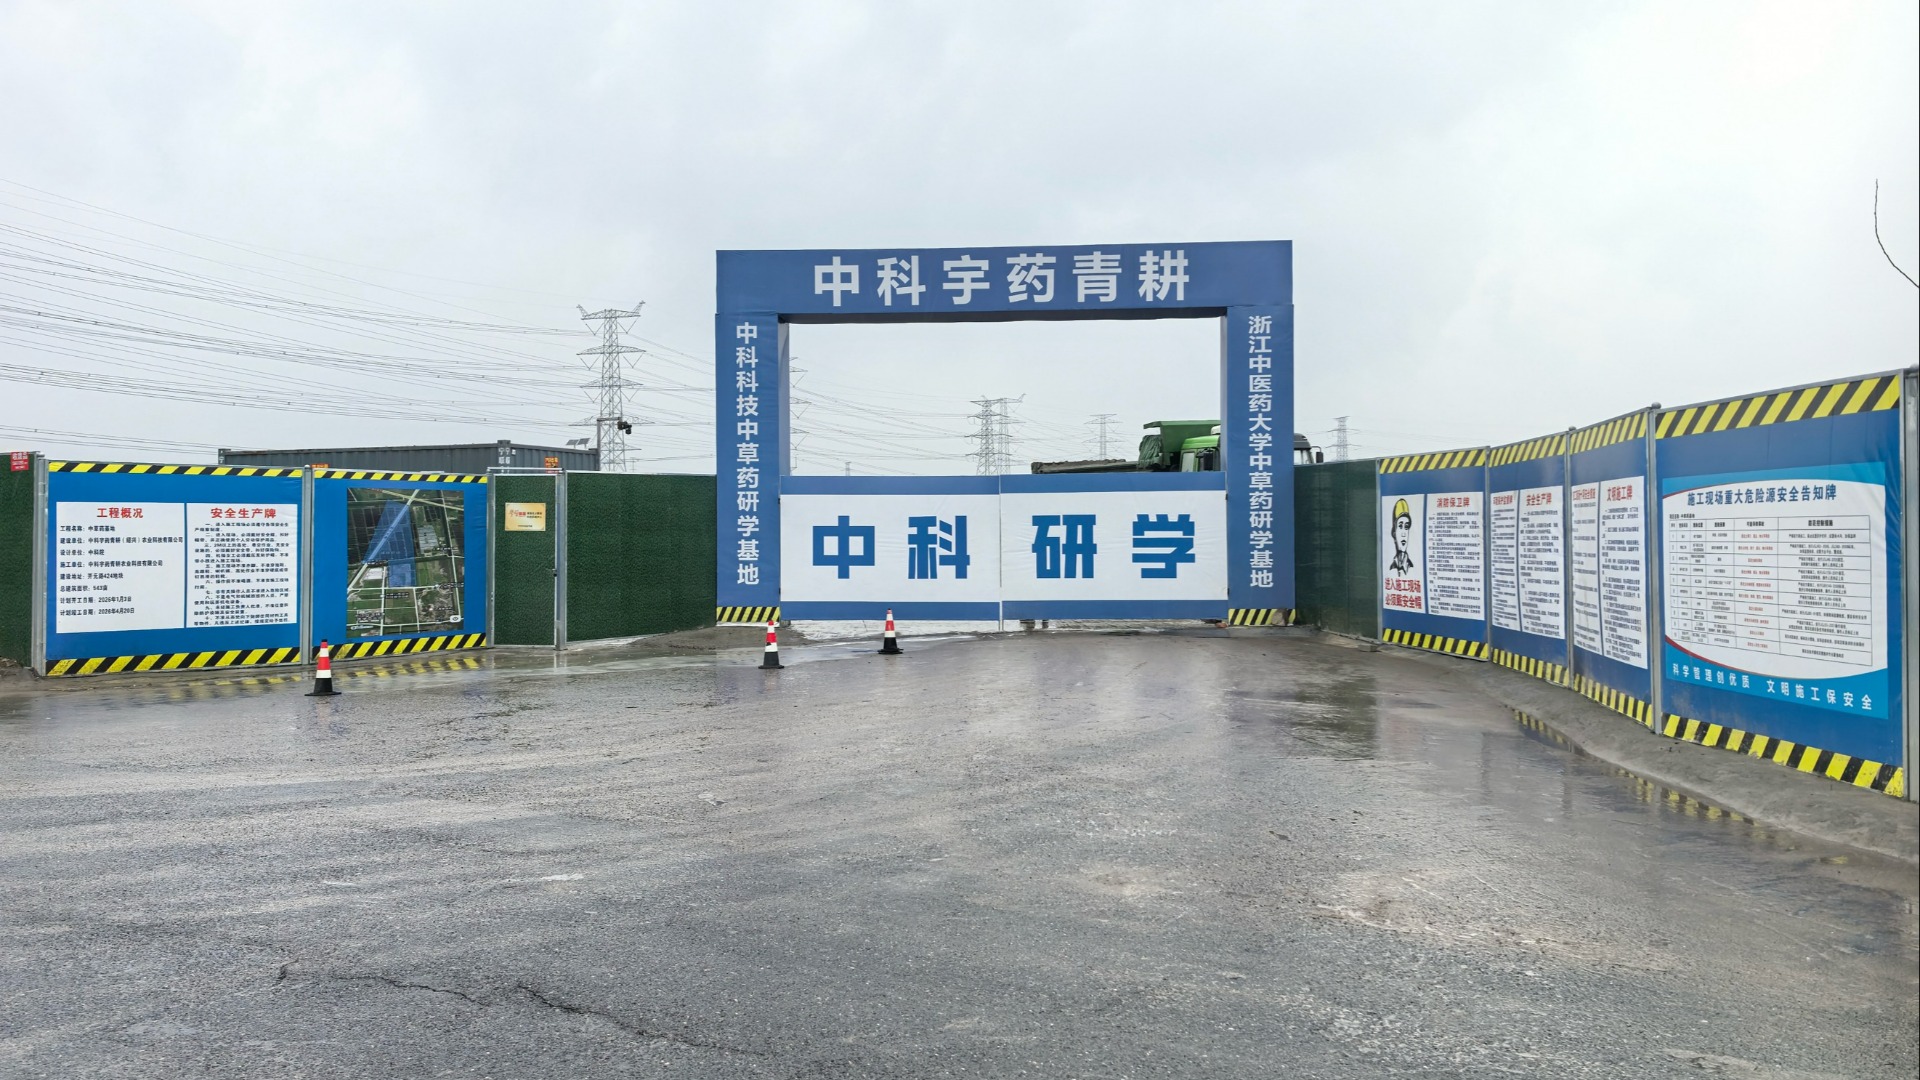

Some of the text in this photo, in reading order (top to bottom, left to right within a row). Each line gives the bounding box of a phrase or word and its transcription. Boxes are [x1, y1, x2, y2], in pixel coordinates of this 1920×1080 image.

[814, 249, 1190, 307] 中科宇药青耕
[735, 321, 760, 586] 中科科技中草药研学基地
[1248, 315, 1273, 588] 浙江中医药大学中草药研学基地
[1687, 484, 1837, 506] 施工现场重大危险源安全告知牌
[97, 507, 144, 519] 工程概况
[210, 507, 277, 519] 安全生产牌
[1385, 577, 1422, 593] 进入施工现场
[1672, 663, 1872, 710] 科学管理创优质 文明施工保安全
